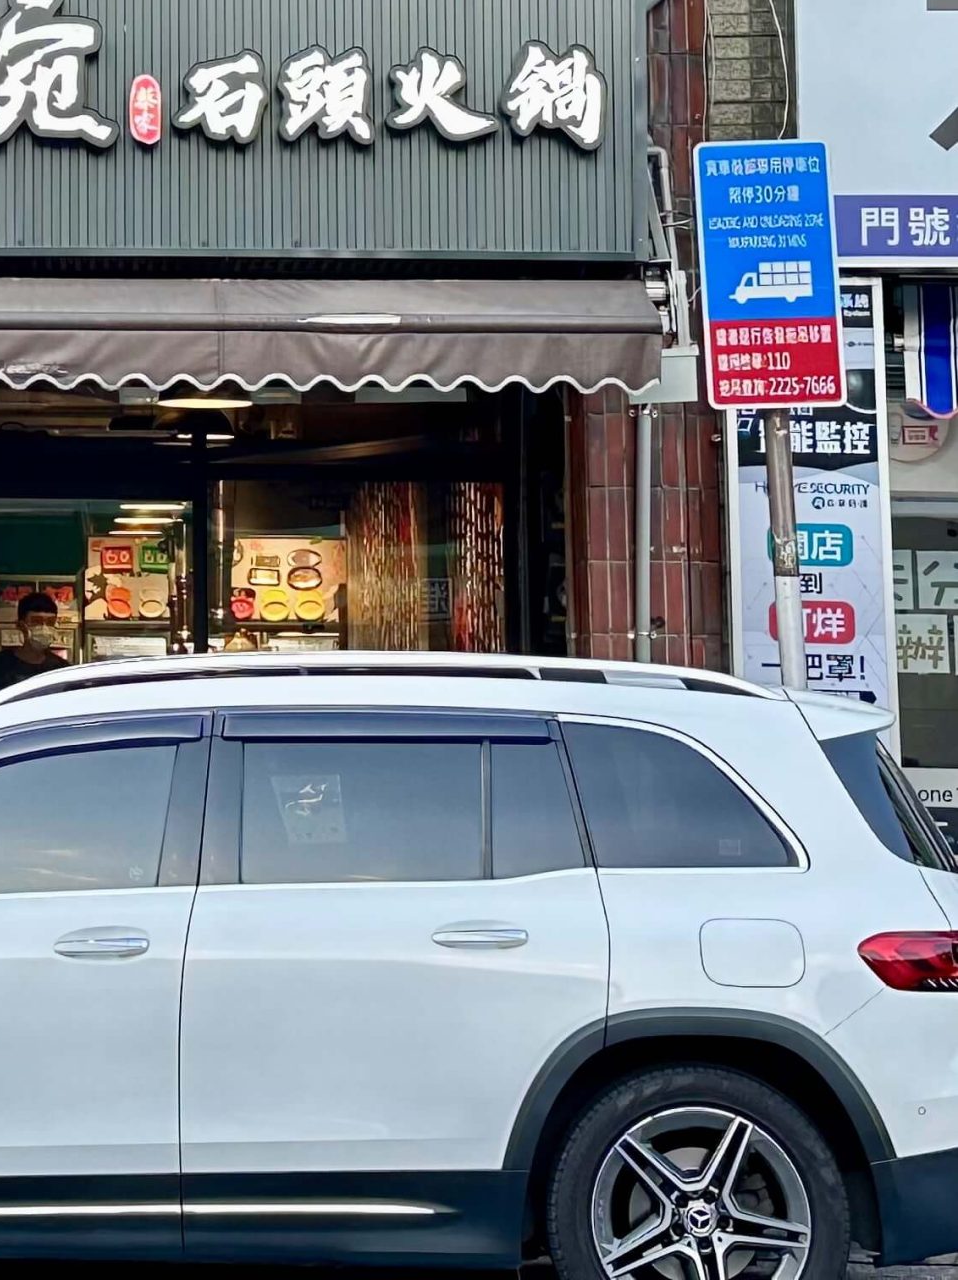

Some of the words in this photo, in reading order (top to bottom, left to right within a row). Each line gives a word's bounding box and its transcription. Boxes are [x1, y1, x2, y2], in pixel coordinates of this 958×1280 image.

[180, 45, 602, 144] 石頭火鍋
[861, 206, 958, 247] 門號
[757, 420, 871, 455] 能監控
